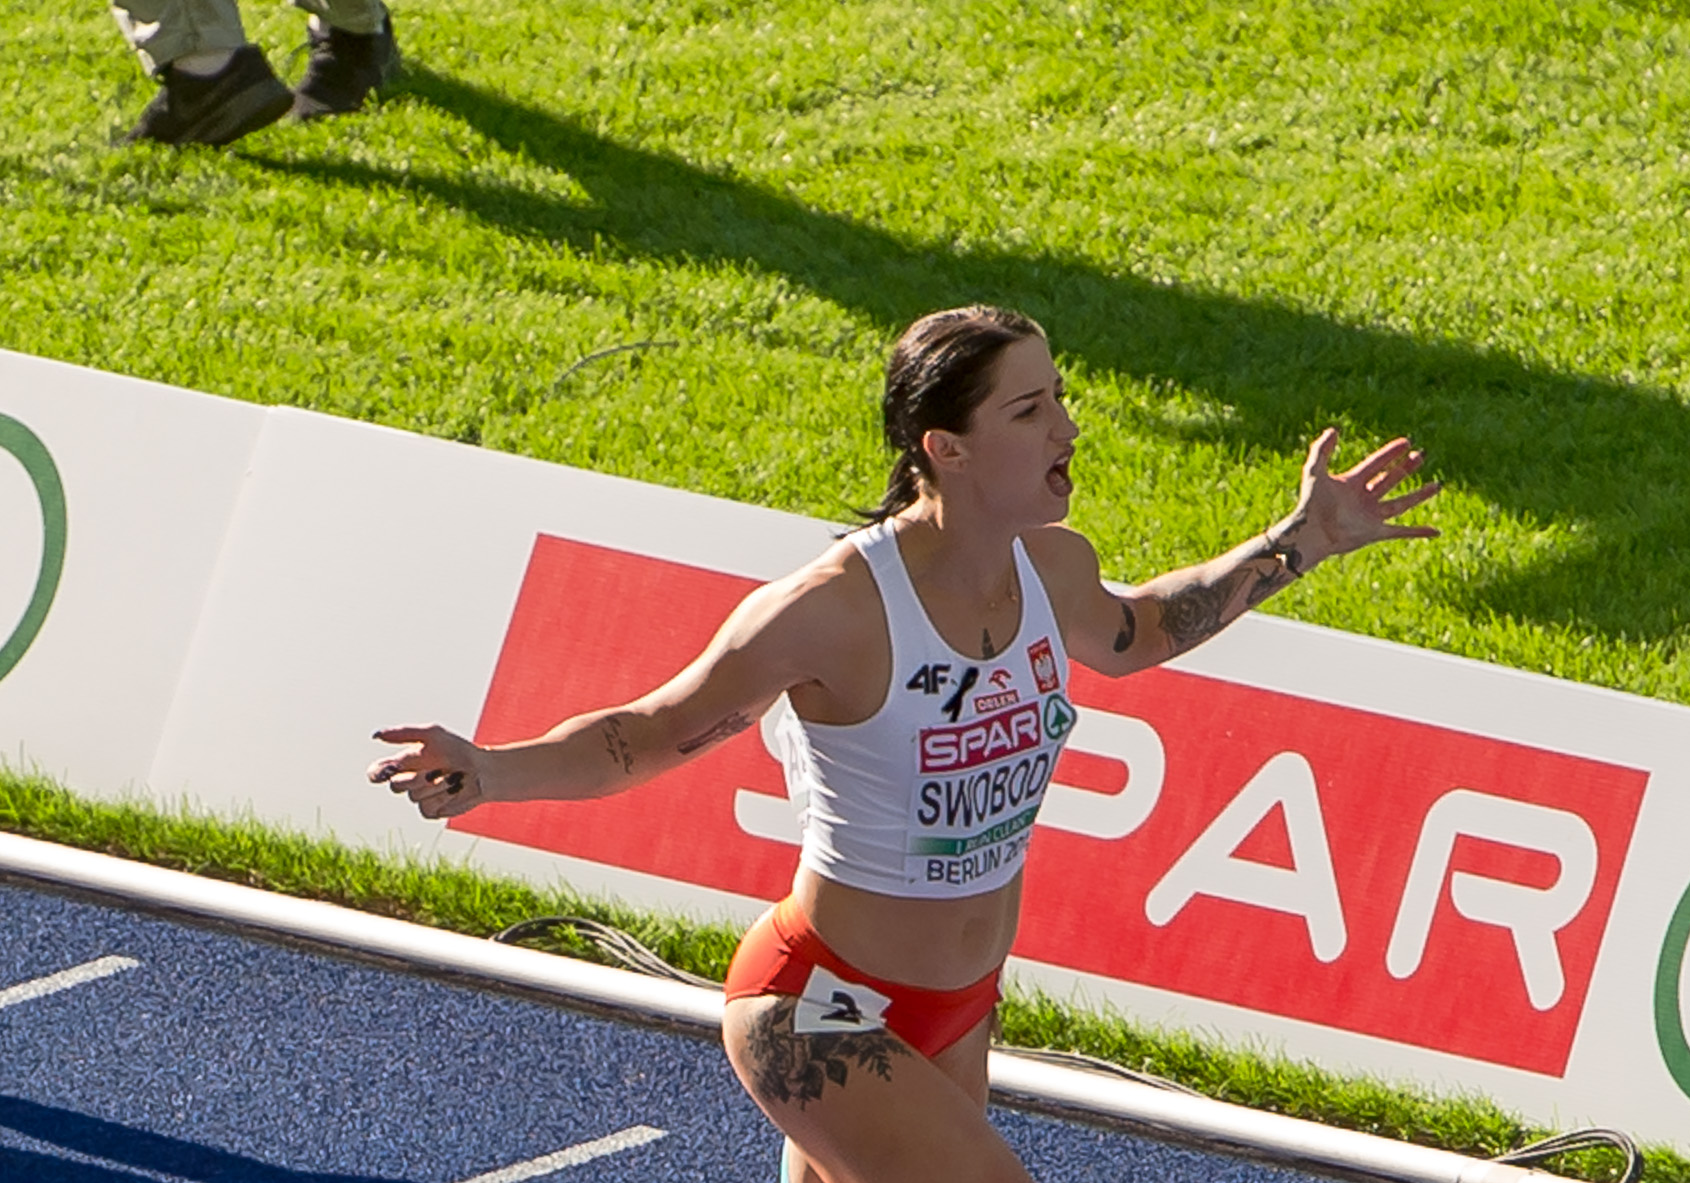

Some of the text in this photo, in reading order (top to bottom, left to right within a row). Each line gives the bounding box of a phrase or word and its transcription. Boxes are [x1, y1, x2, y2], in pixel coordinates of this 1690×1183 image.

[906, 664, 951, 694] 4F
[925, 709, 1037, 767] SPAR
[926, 844, 1002, 885] BERLIN
[820, 990, 861, 1025] 2
